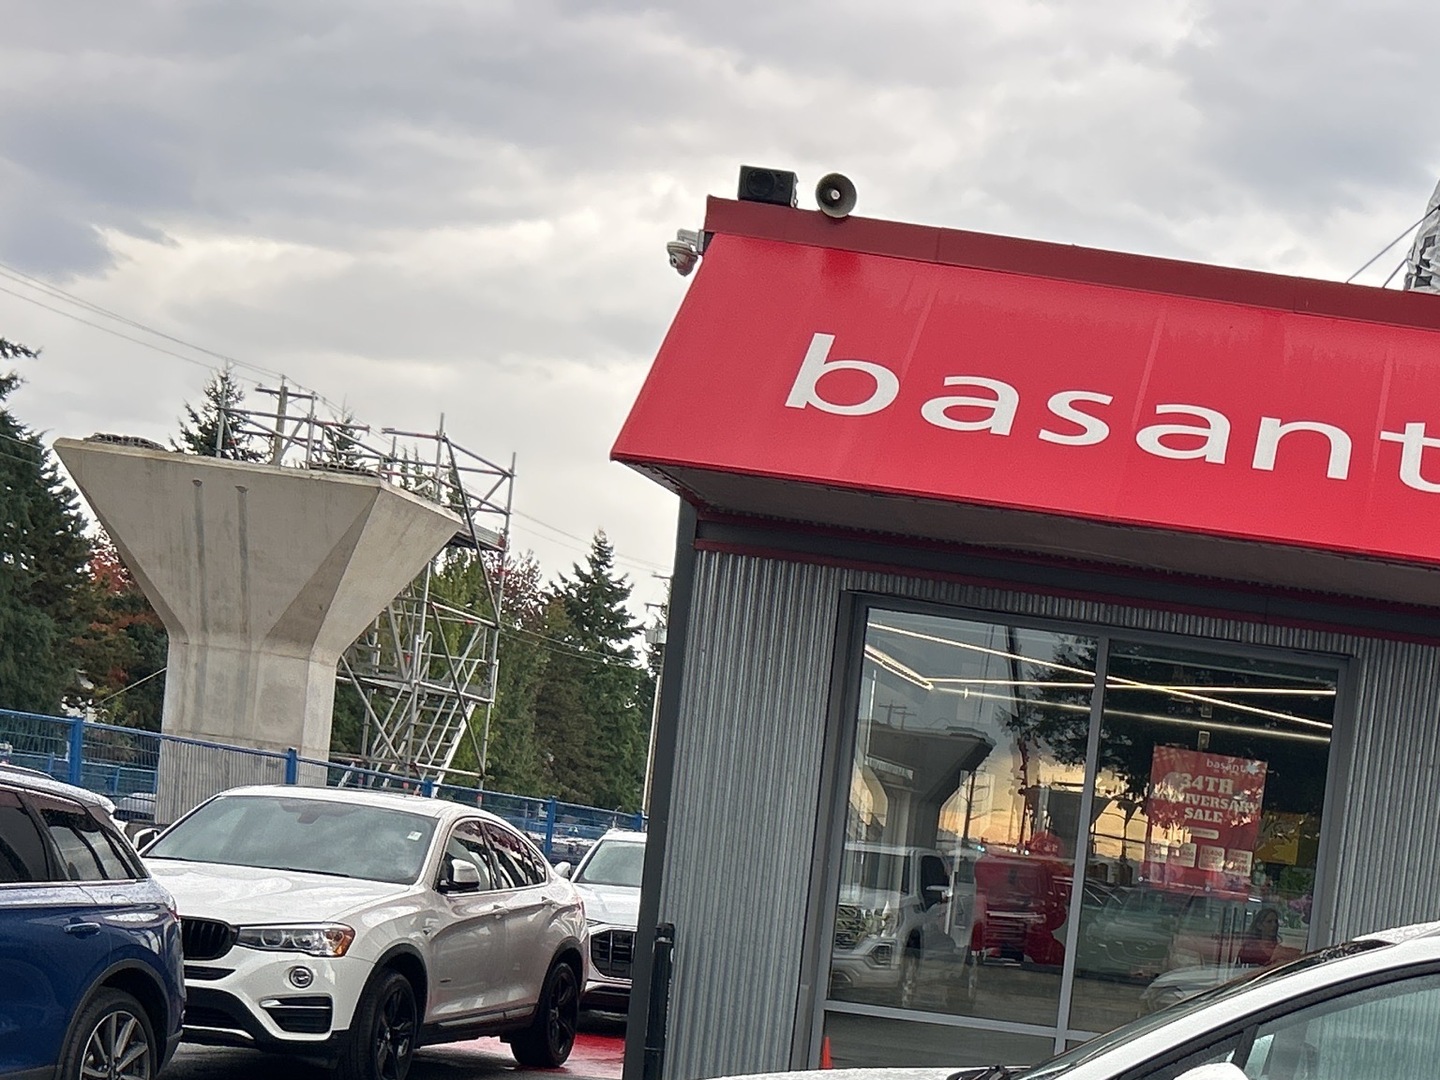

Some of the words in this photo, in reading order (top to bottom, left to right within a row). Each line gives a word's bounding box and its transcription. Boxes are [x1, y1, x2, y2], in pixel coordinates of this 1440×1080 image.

[1206, 758, 1247, 773] basant
[1180, 772, 1235, 795] 34TH
[1150, 786, 1259, 814] AIVERSARY
[1184, 807, 1224, 824] SALE
